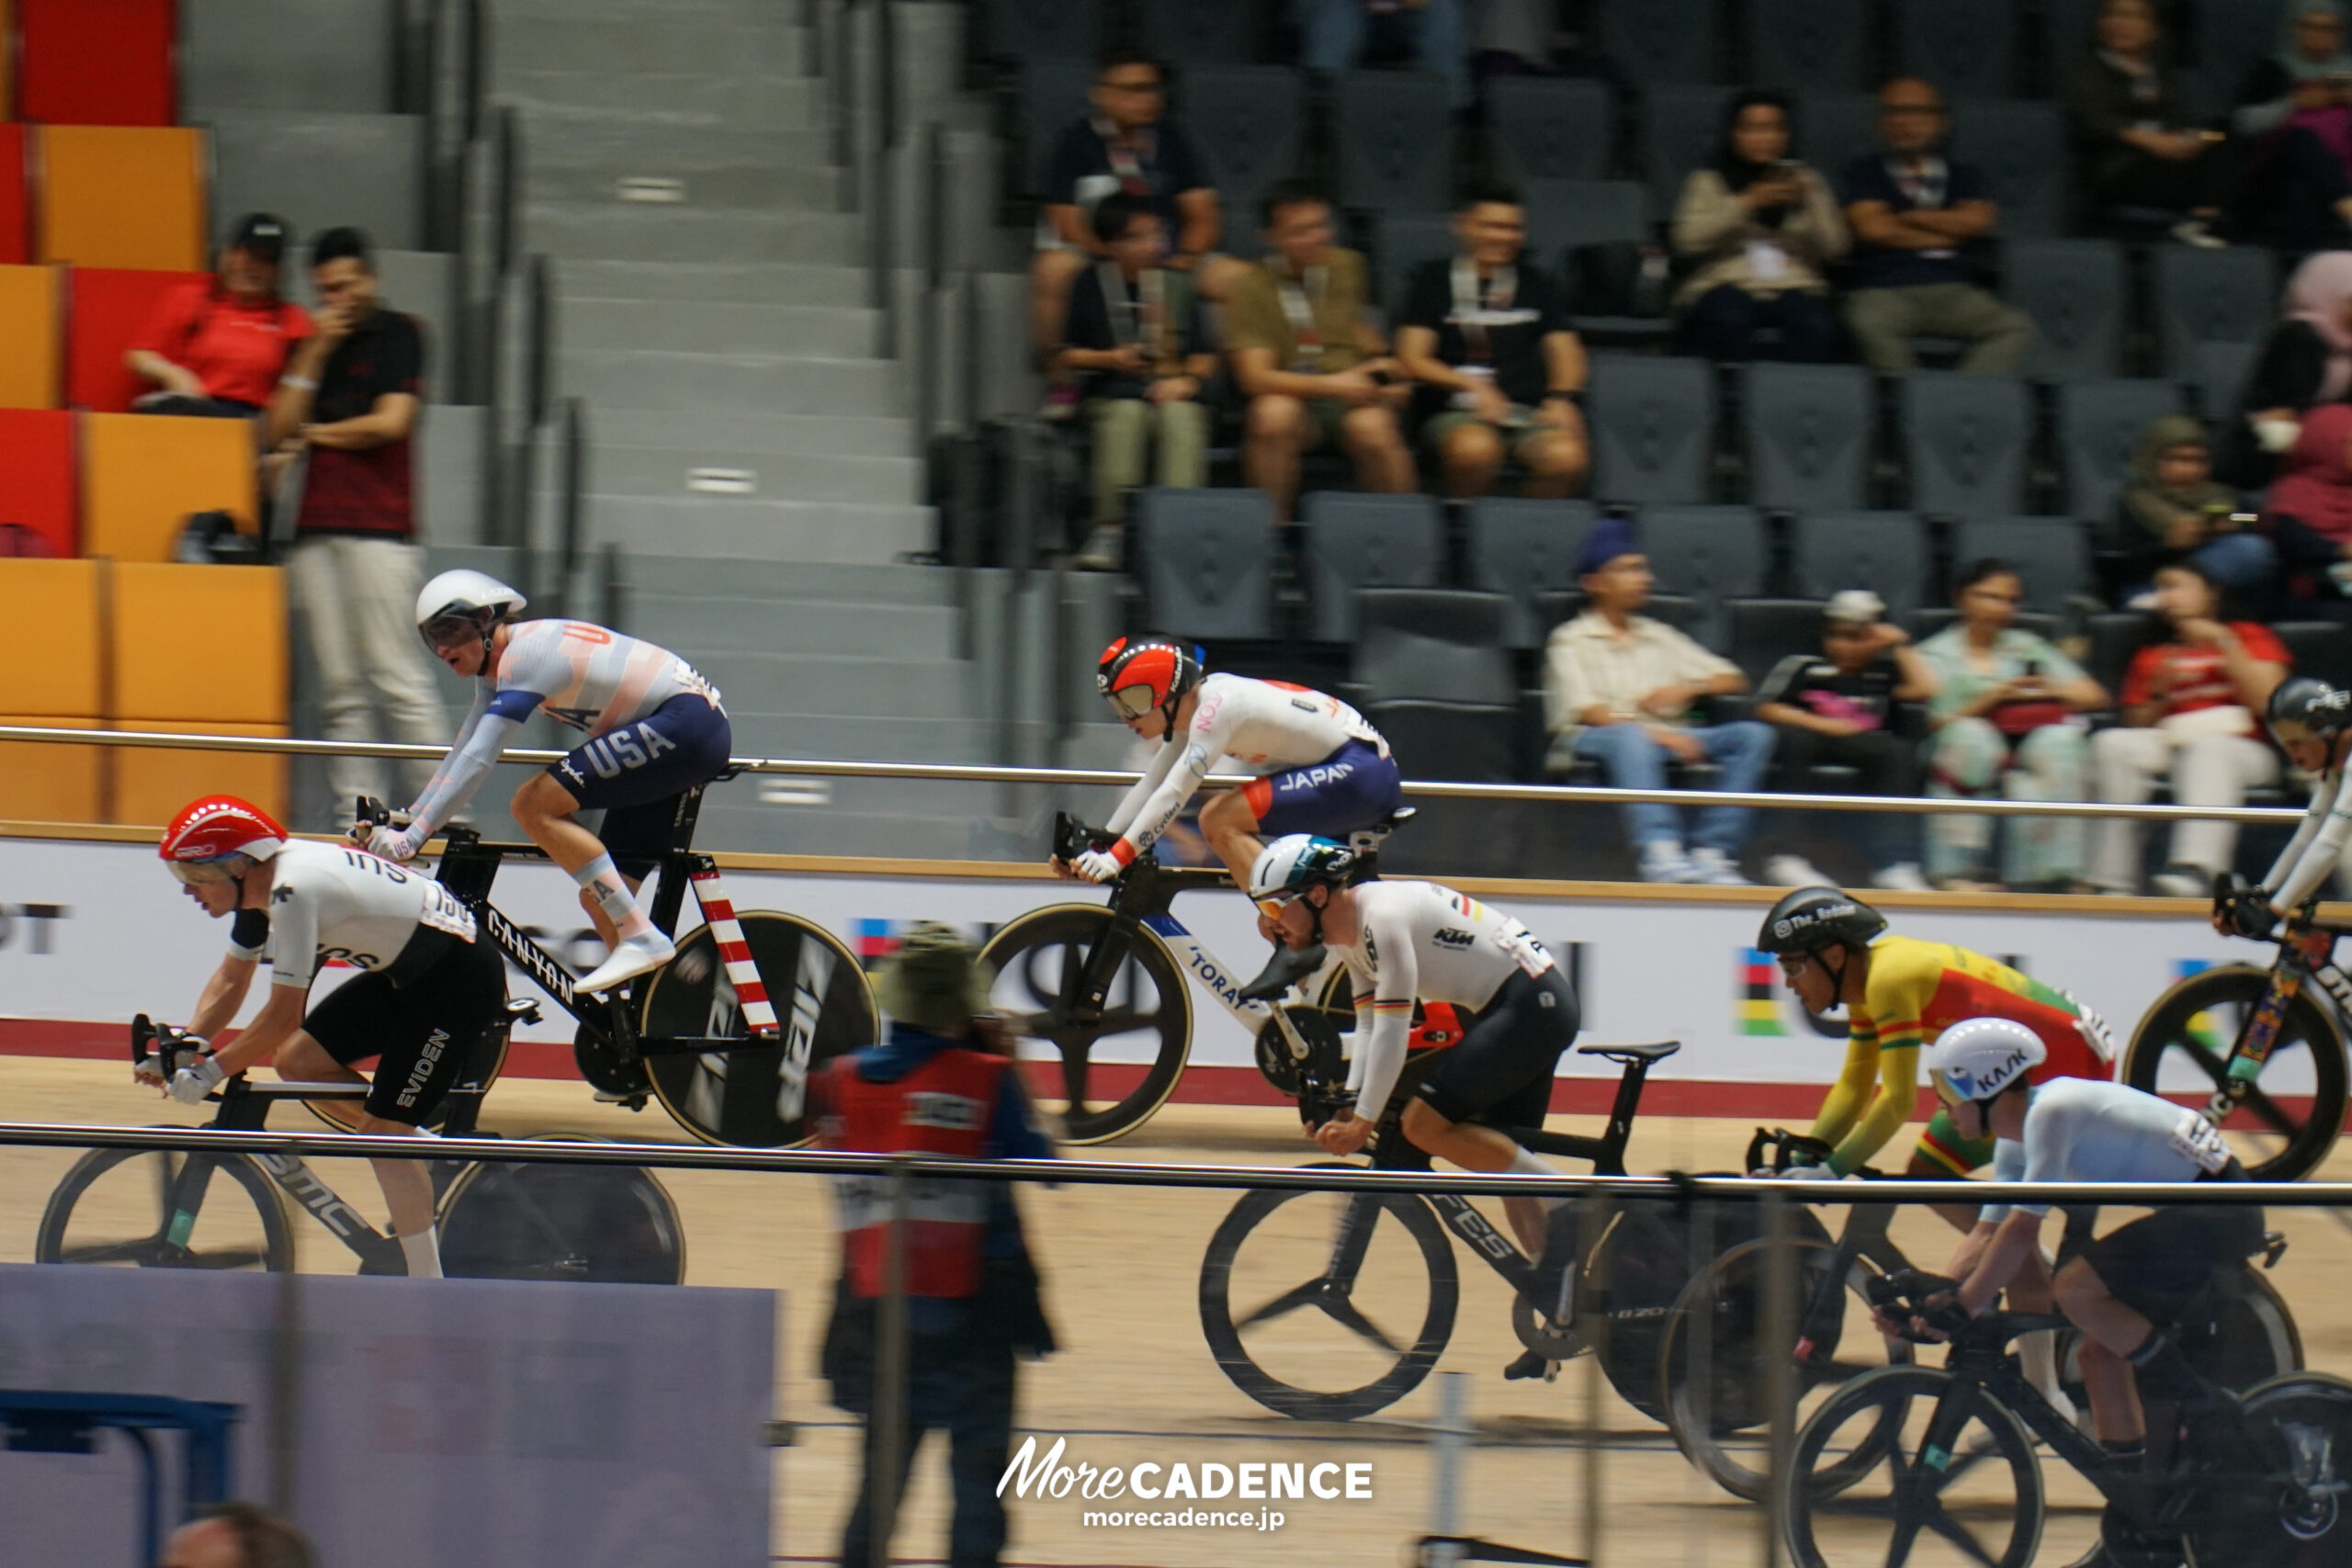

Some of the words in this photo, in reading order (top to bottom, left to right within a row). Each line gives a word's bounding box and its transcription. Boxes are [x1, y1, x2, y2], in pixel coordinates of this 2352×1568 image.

[583, 722, 676, 779] USA
[1280, 762, 1353, 791] JAPAN
[175, 843, 217, 859] GIRO
[488, 908, 573, 1006] CANYON
[396, 1027, 451, 1108] EVIDEN
[1977, 1048, 2029, 1093] KASK
